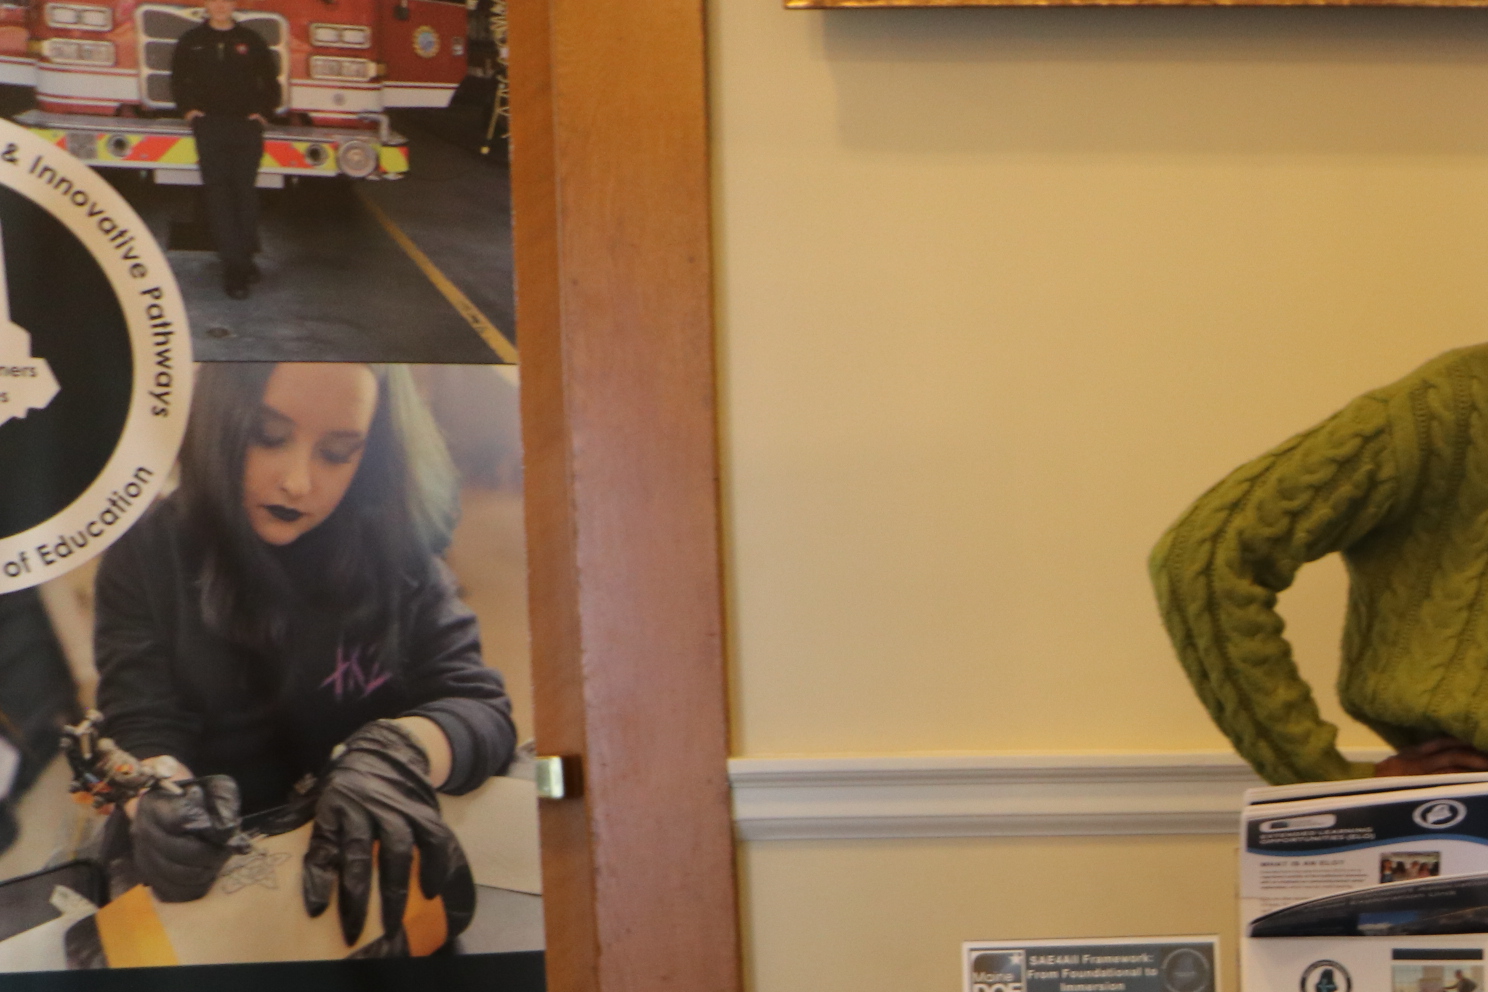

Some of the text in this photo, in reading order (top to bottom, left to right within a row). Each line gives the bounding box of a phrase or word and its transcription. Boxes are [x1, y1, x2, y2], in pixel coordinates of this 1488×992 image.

[1, 142, 175, 418] & Innovative Pathways
[3, 465, 154, 578] of Education
